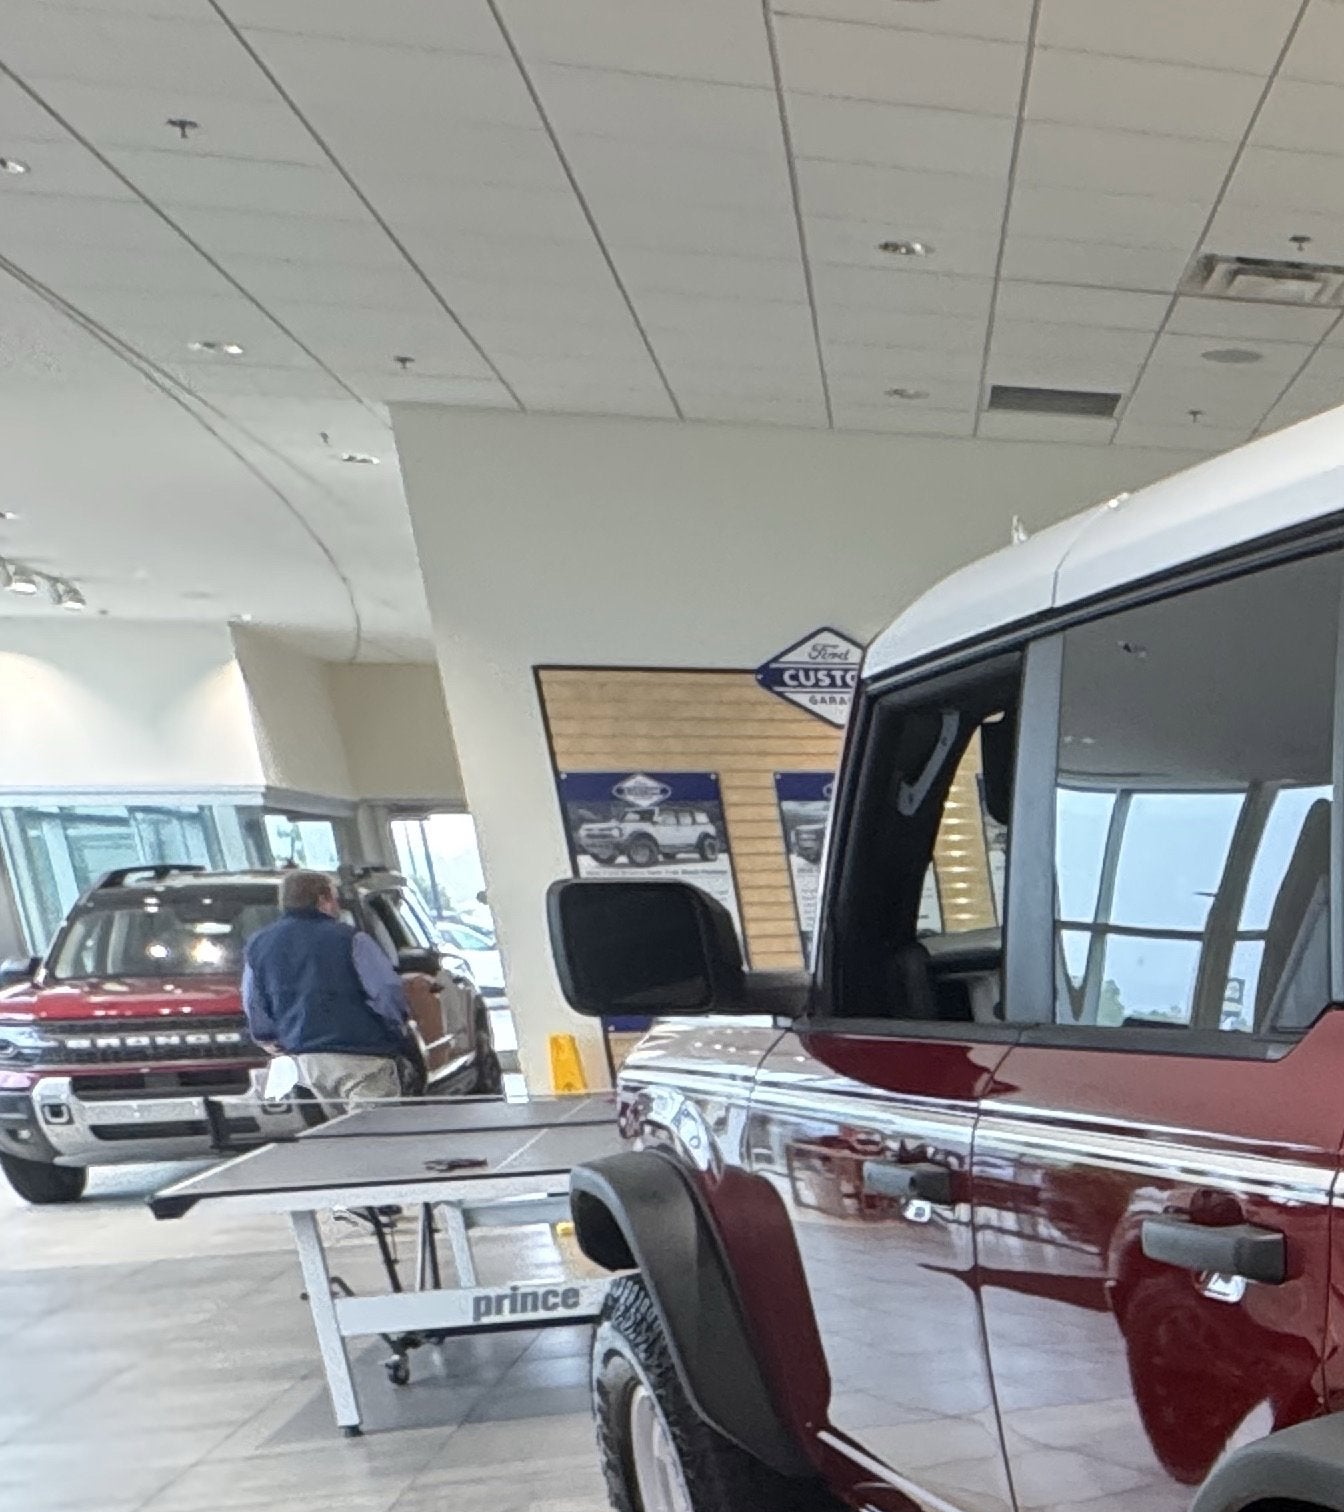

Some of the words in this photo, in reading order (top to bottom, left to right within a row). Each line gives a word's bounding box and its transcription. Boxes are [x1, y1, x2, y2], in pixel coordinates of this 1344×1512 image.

[808, 643, 850, 660] Ford
[808, 694, 850, 705] GARA
[472, 1284, 580, 1322] prince
